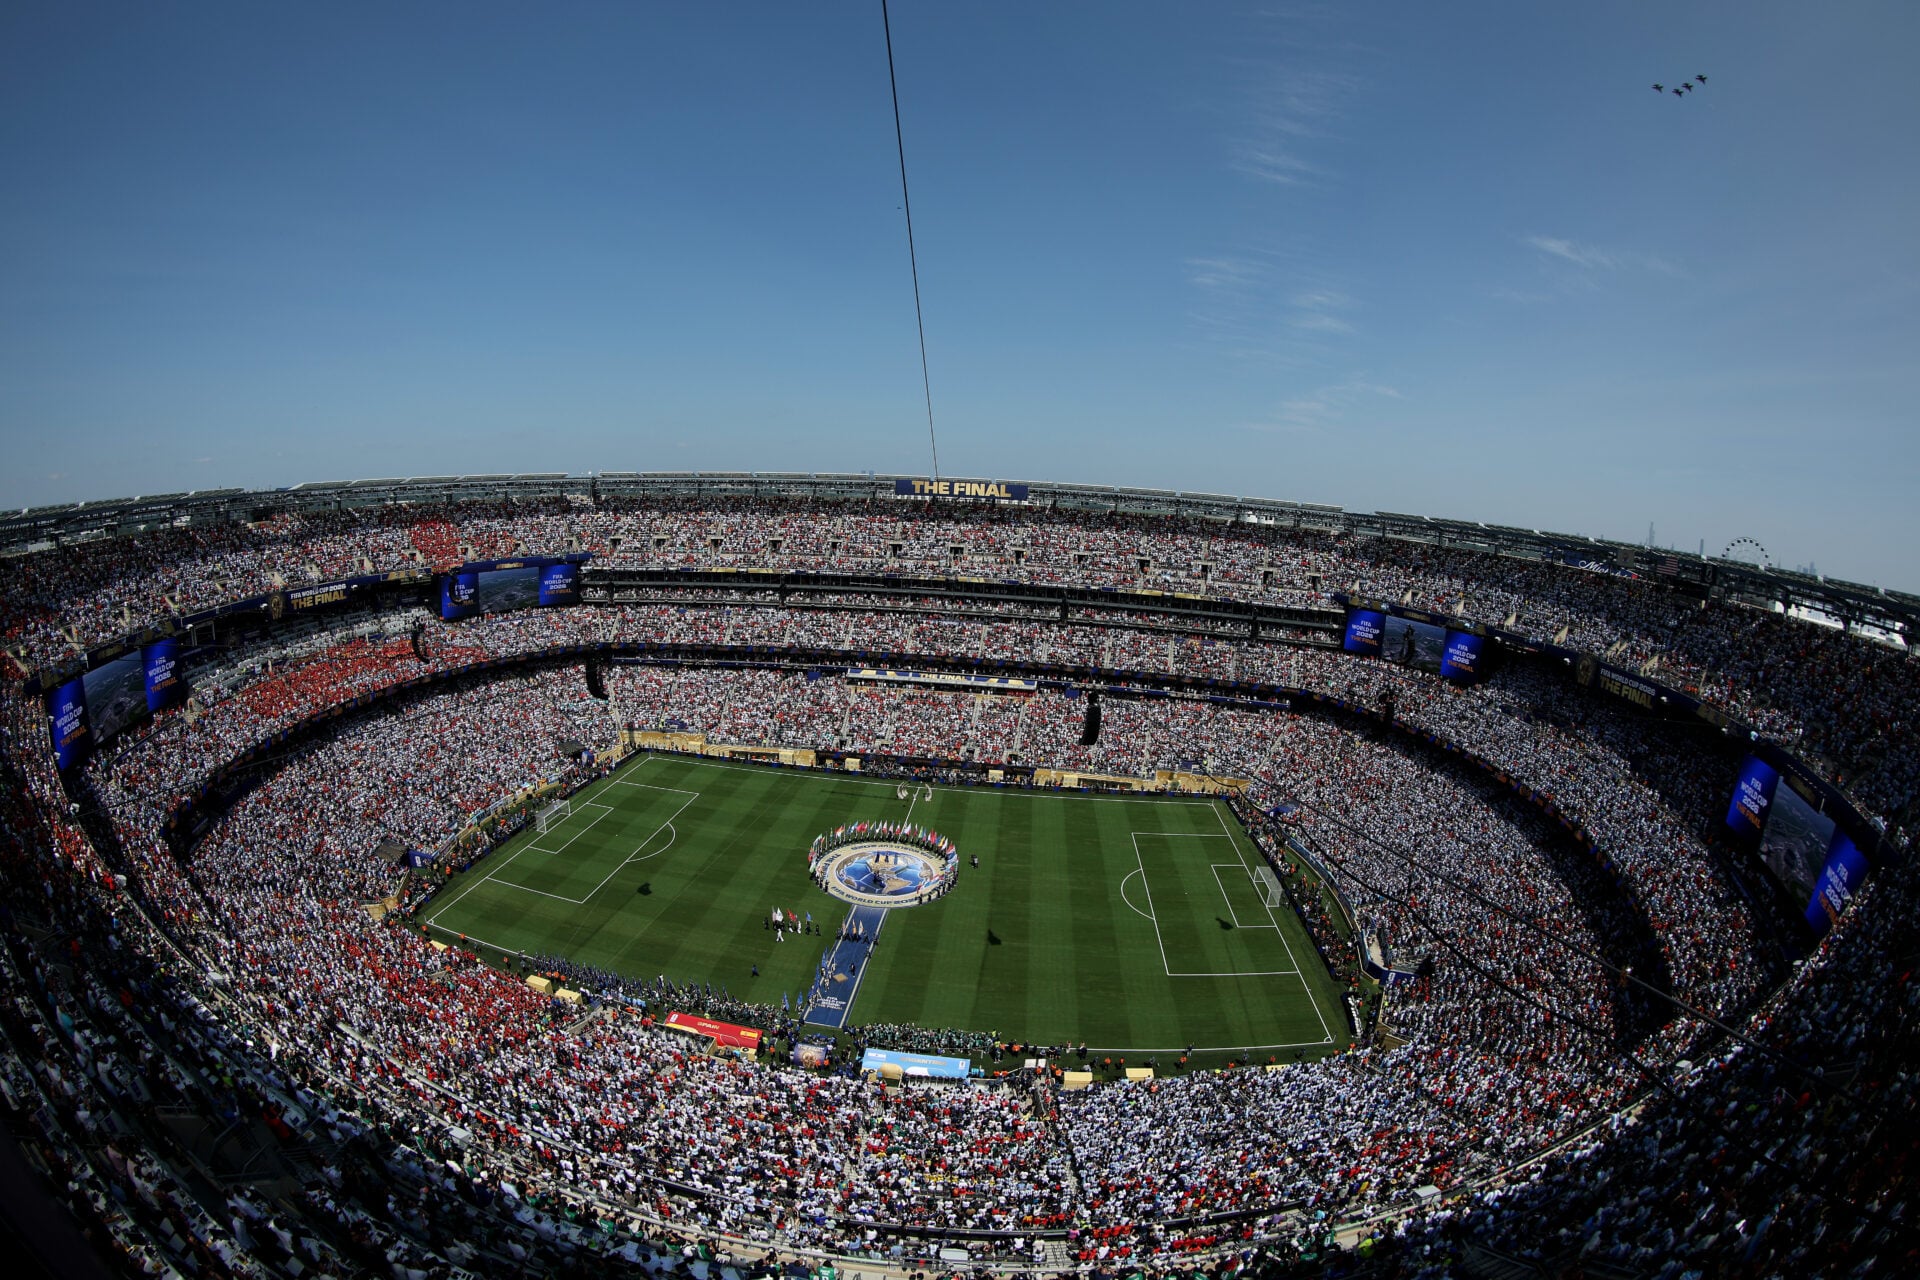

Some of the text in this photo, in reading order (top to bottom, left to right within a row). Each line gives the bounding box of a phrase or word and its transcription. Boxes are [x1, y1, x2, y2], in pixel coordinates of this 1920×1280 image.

[912, 480, 1011, 497] THE FINAL
[290, 591, 301, 599] FIFA
[302, 588, 319, 597] WORLD
[329, 584, 346, 592] 2026
[291, 590, 346, 609] THE FINAL
[1352, 624, 1369, 632] WORLD
[1356, 630, 1374, 639] 2026
[1362, 637, 1378, 646] FINAL
[1448, 647, 1466, 657] WORLD
[1452, 654, 1470, 665] 2026
[148, 660, 176, 677] WORLD CUP
[154, 670, 171, 684] 2026
[1600, 668, 1656, 696] FIFA WORLD CUP 2026
[150, 678, 176, 694] THE FINAL
[1600, 676, 1653, 710] THE FINAL
[62, 702, 74, 714] FIFA
[56, 706, 83, 728] WORLD CUP
[62, 720, 80, 735] 2026
[1750, 777, 1762, 792] FIFA
[1741, 780, 1768, 808] WORLD CUP
[1742, 794, 1760, 814] 2026
[1826, 865, 1843, 892] WORLD
[1837, 862, 1848, 883] FIFA
[846, 894, 873, 904] WORLD
[1826, 884, 1842, 912] 2026
[697, 1022, 720, 1030] SPAIN
